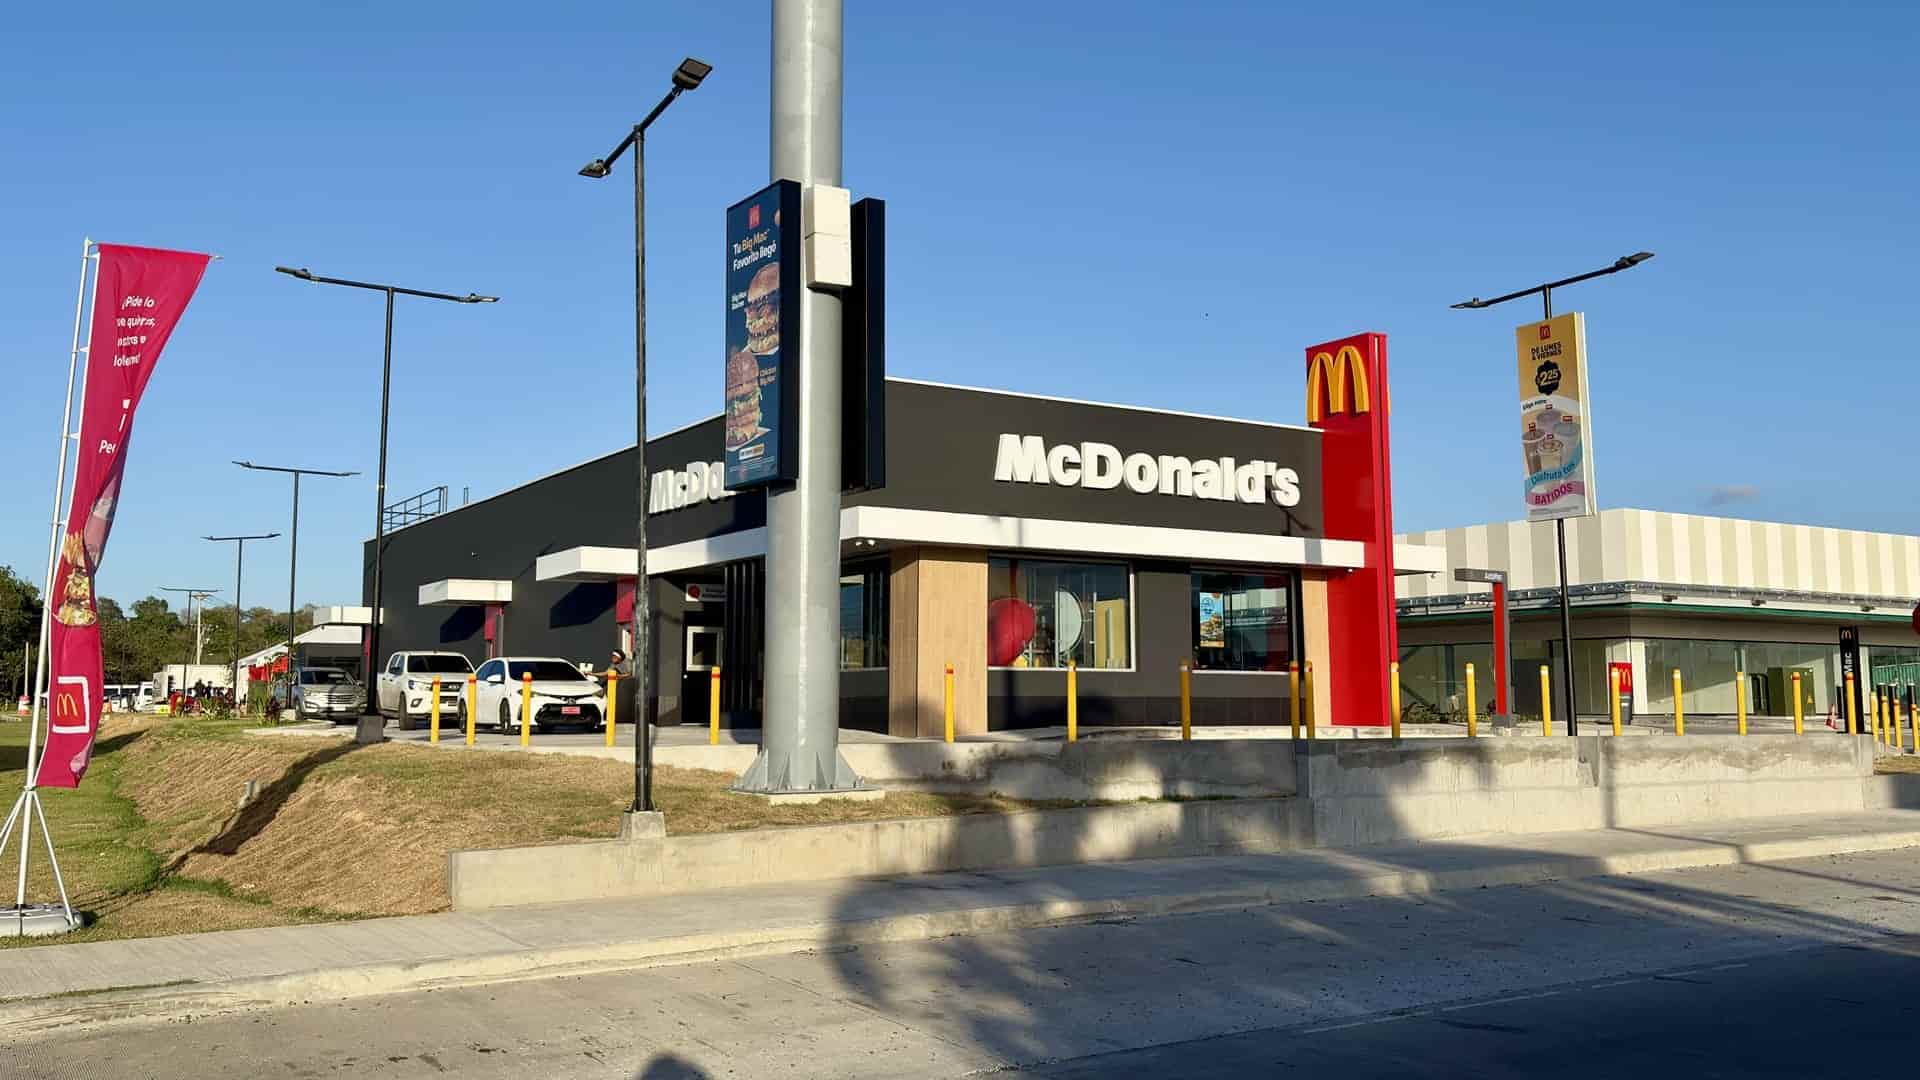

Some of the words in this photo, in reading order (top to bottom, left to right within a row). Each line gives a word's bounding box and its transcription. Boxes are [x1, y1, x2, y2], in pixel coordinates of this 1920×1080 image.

[742, 236, 752, 252] Big
[144, 297, 154, 307] lo
[994, 433, 1301, 507] McDonald's
[1535, 482, 1572, 505] BATIDOS
